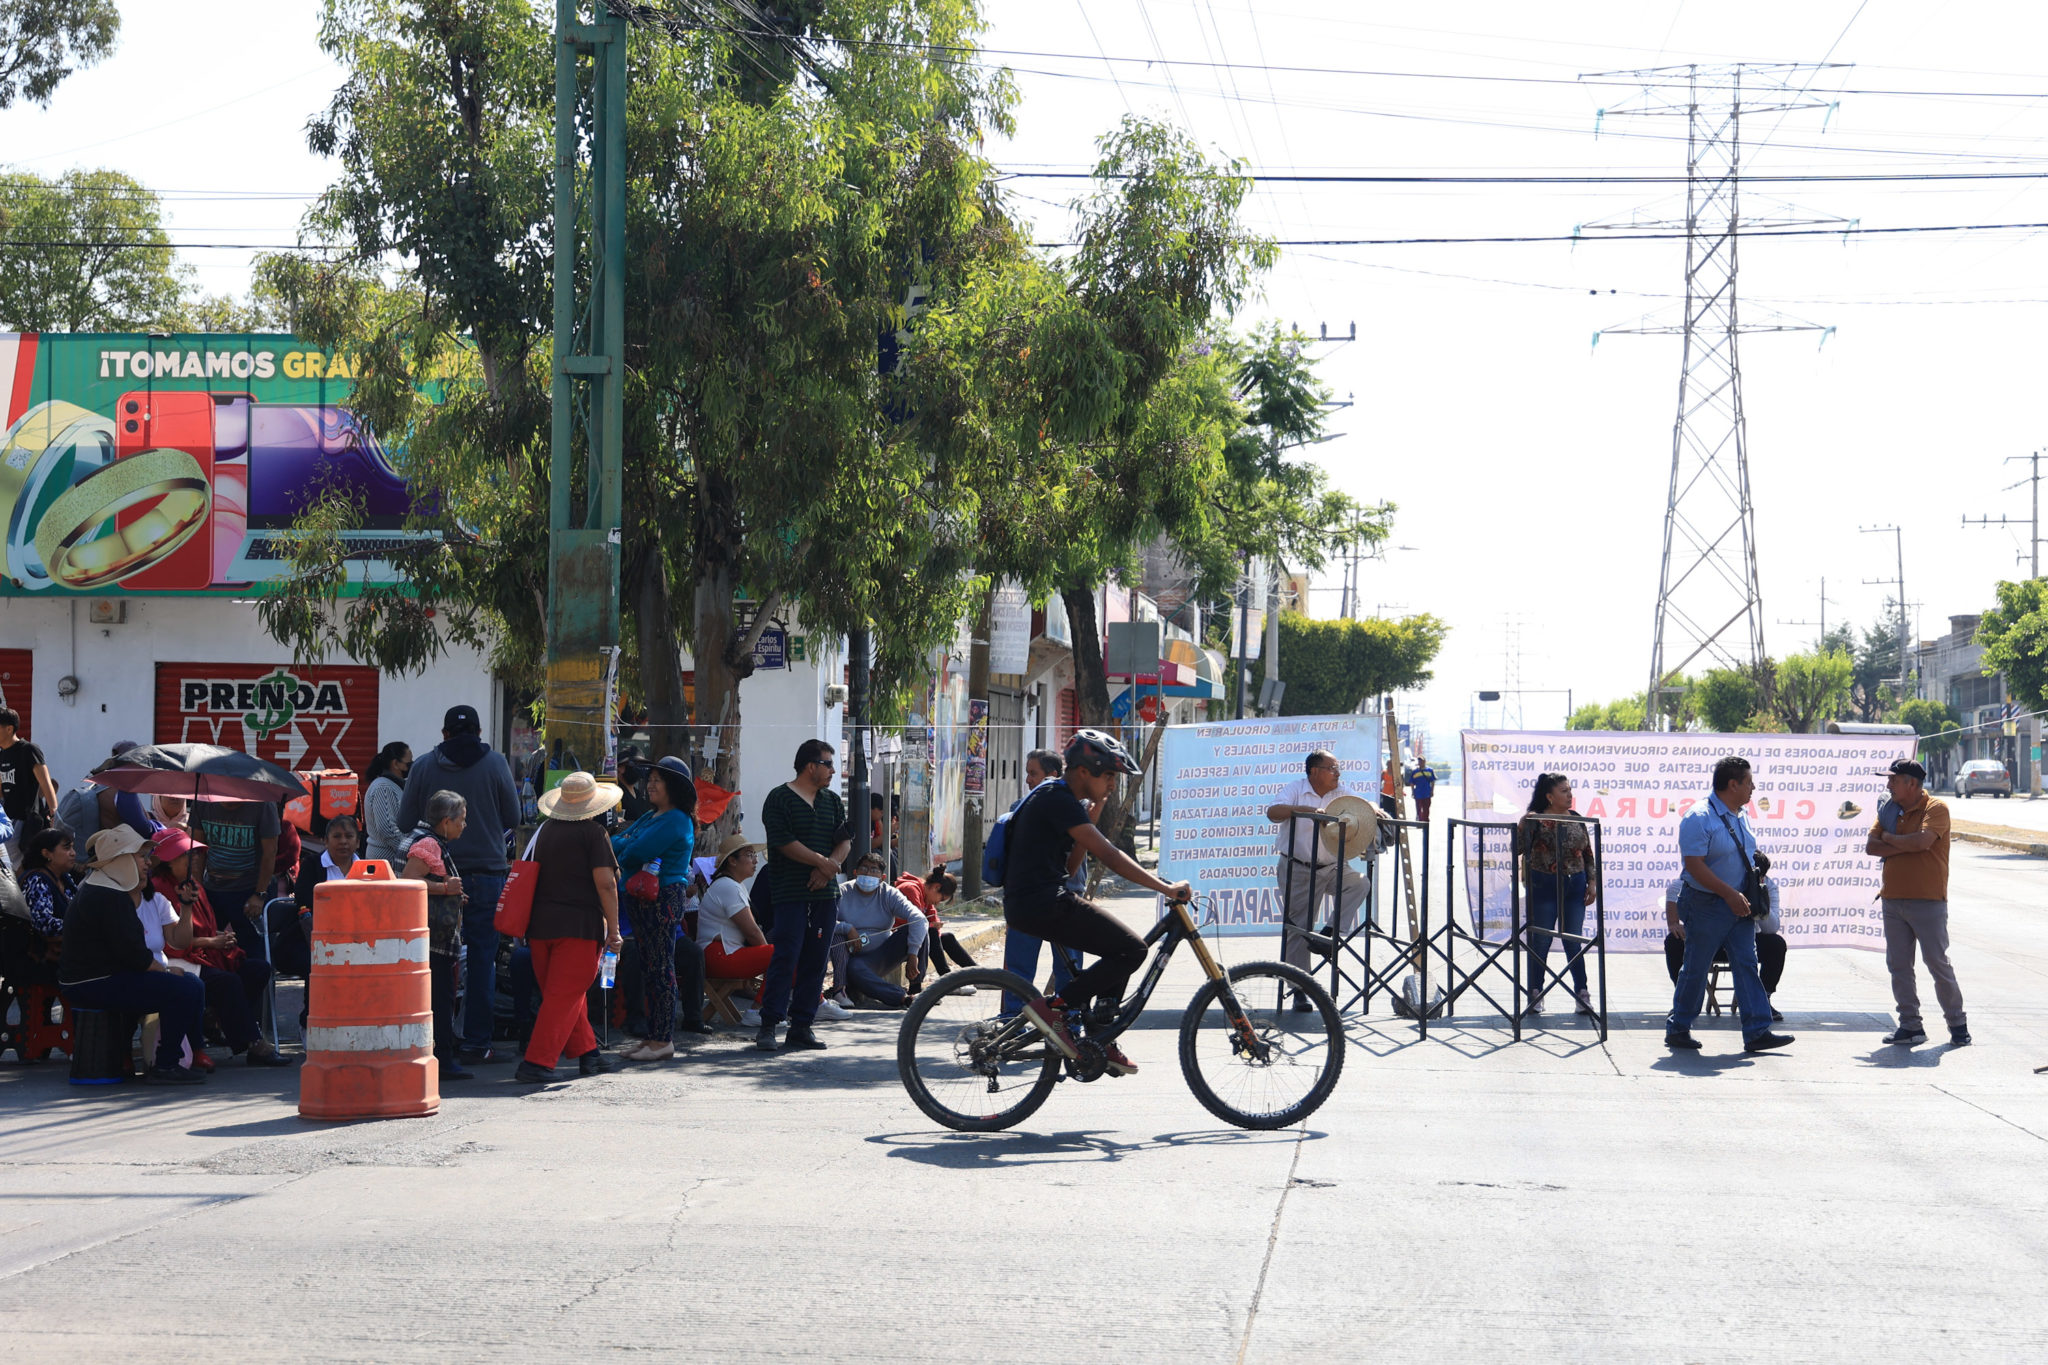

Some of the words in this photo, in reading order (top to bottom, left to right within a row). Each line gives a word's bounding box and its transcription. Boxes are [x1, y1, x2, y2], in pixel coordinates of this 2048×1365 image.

[100, 351, 275, 379] ¡TOMAMOS
[182, 681, 345, 712] PRENDA
[182, 717, 353, 771] MEX
